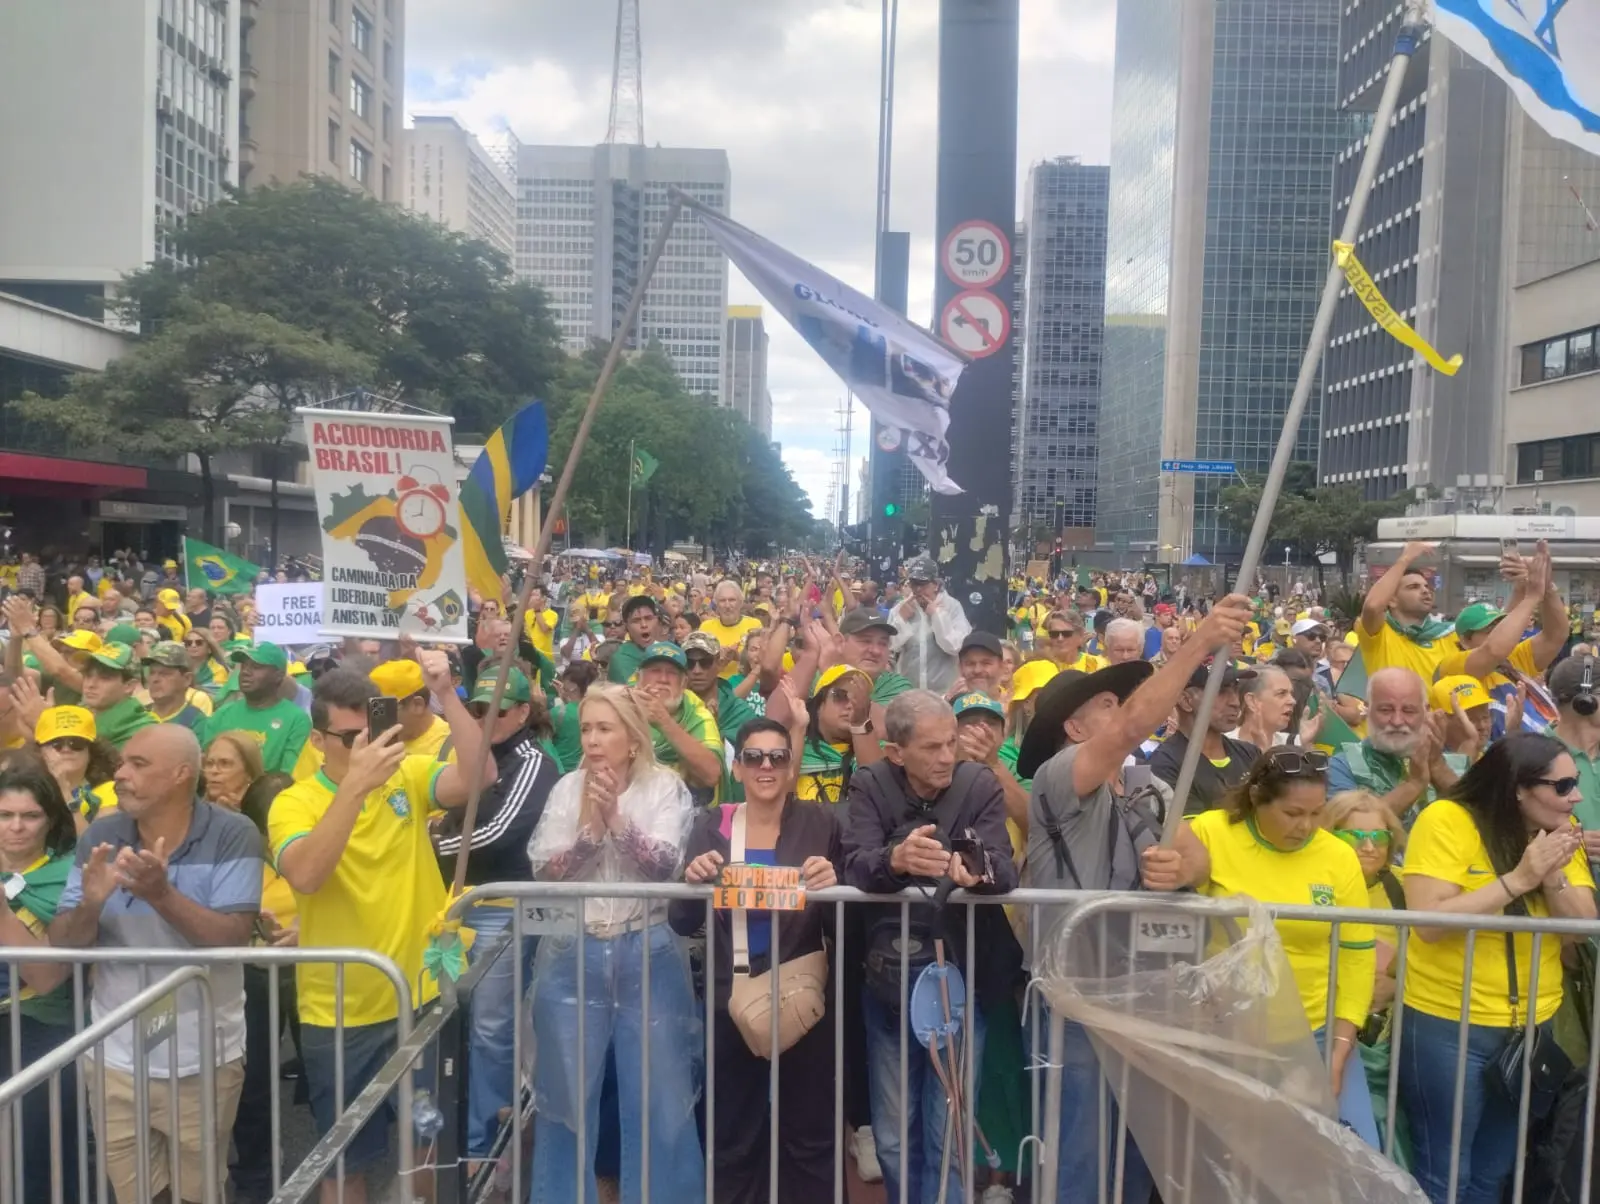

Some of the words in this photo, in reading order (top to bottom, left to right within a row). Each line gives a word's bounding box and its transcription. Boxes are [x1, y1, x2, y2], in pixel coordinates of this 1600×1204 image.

[955, 239, 997, 265] 50
[962, 268, 989, 276] km/h
[316, 448, 402, 475] BRASIL!
[399, 573, 417, 588] DA
[282, 595, 316, 610] FREE
[332, 588, 388, 608] LIBERDADE
[258, 612, 323, 627] BOLSONA
[332, 609, 377, 626] ANISTIA
[722, 867, 799, 887] SUPREMO
[738, 891, 746, 906] O
[756, 891, 798, 907] POVO
